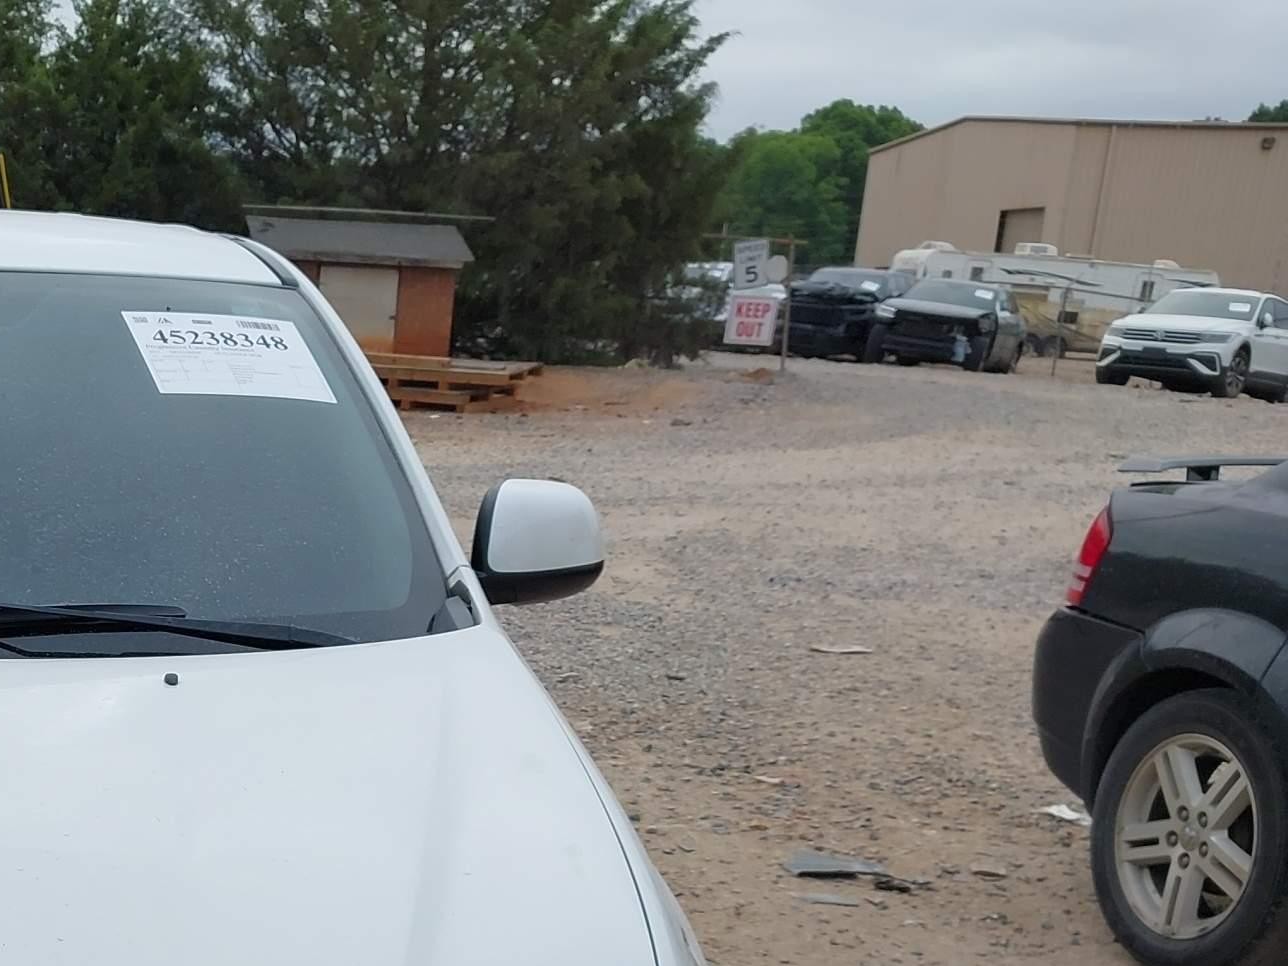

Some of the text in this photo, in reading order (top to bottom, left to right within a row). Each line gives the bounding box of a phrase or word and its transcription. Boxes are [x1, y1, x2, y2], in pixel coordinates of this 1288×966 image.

[745, 266, 759, 283] 5
[735, 302, 771, 319] KEEP
[735, 321, 764, 338] OUT
[152, 329, 289, 351] 45238348
